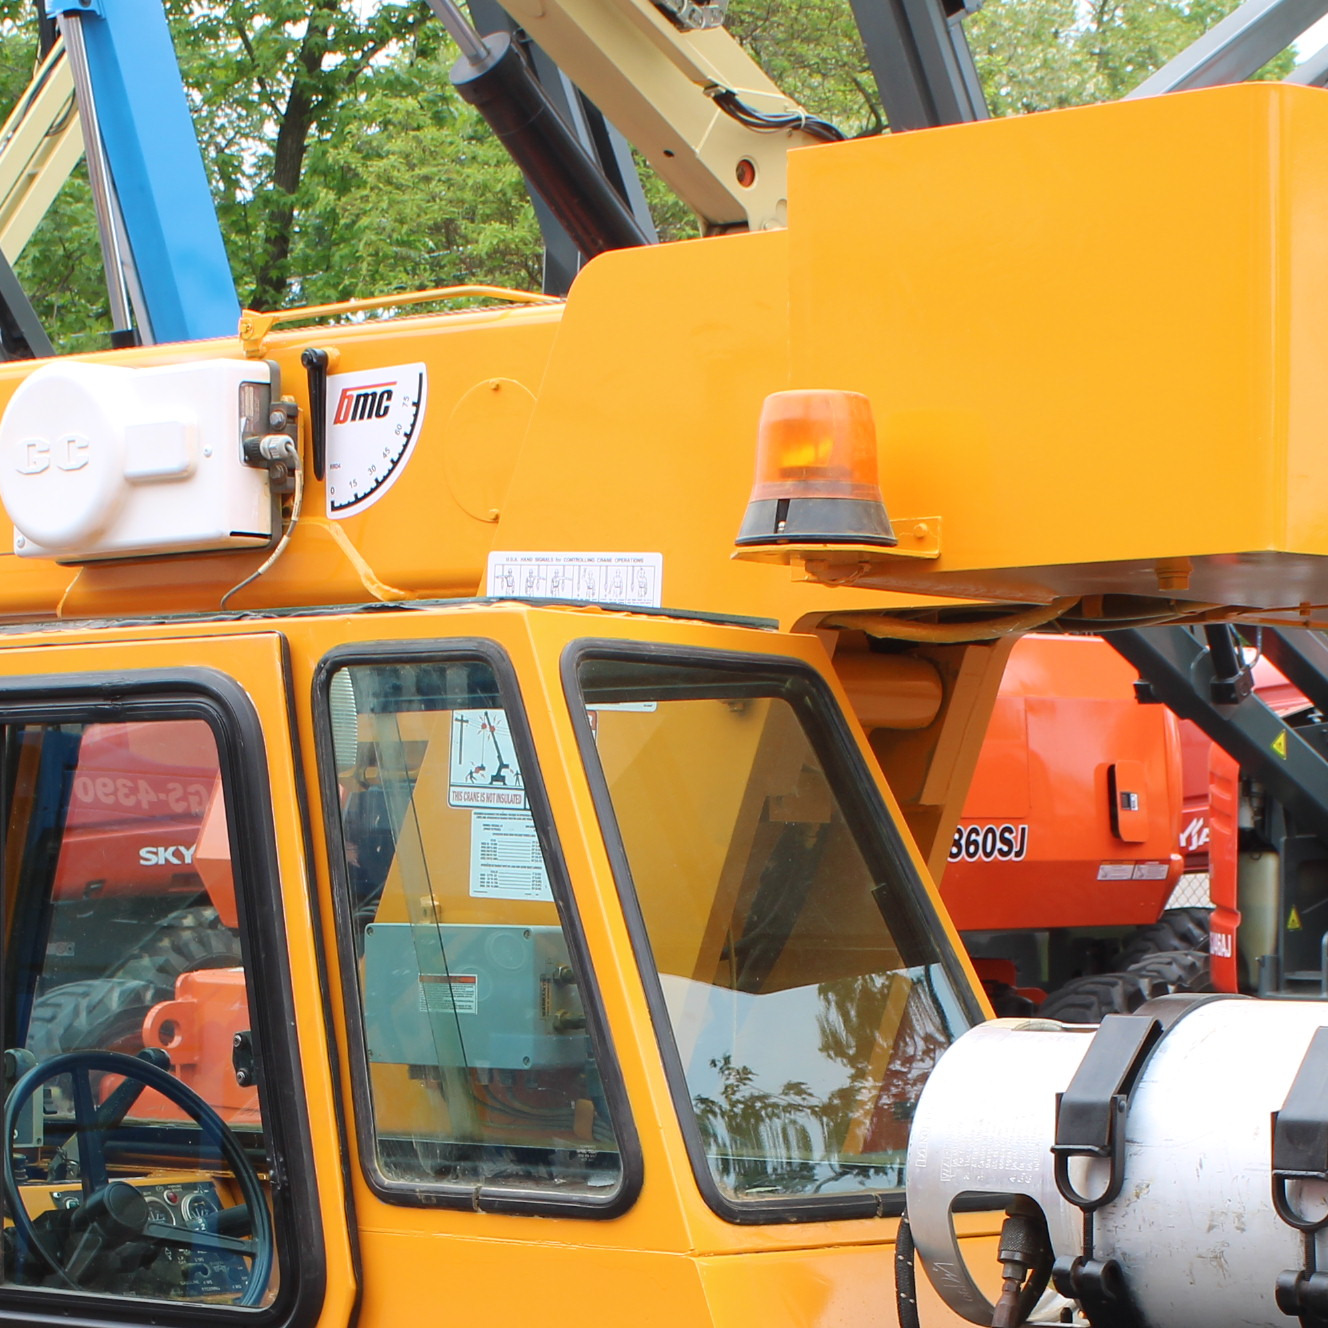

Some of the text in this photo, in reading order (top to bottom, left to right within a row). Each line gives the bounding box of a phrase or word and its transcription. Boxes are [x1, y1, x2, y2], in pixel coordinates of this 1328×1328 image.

[333, 381, 397, 425] bmc
[394, 424, 403, 436] 60
[382, 447, 391, 459] 45
[367, 464, 377, 476] 30
[349, 479, 358, 489] 15
[330, 487, 335, 495] 0
[452, 791, 522, 805] THIS CRANE IS NOT INSULATED
